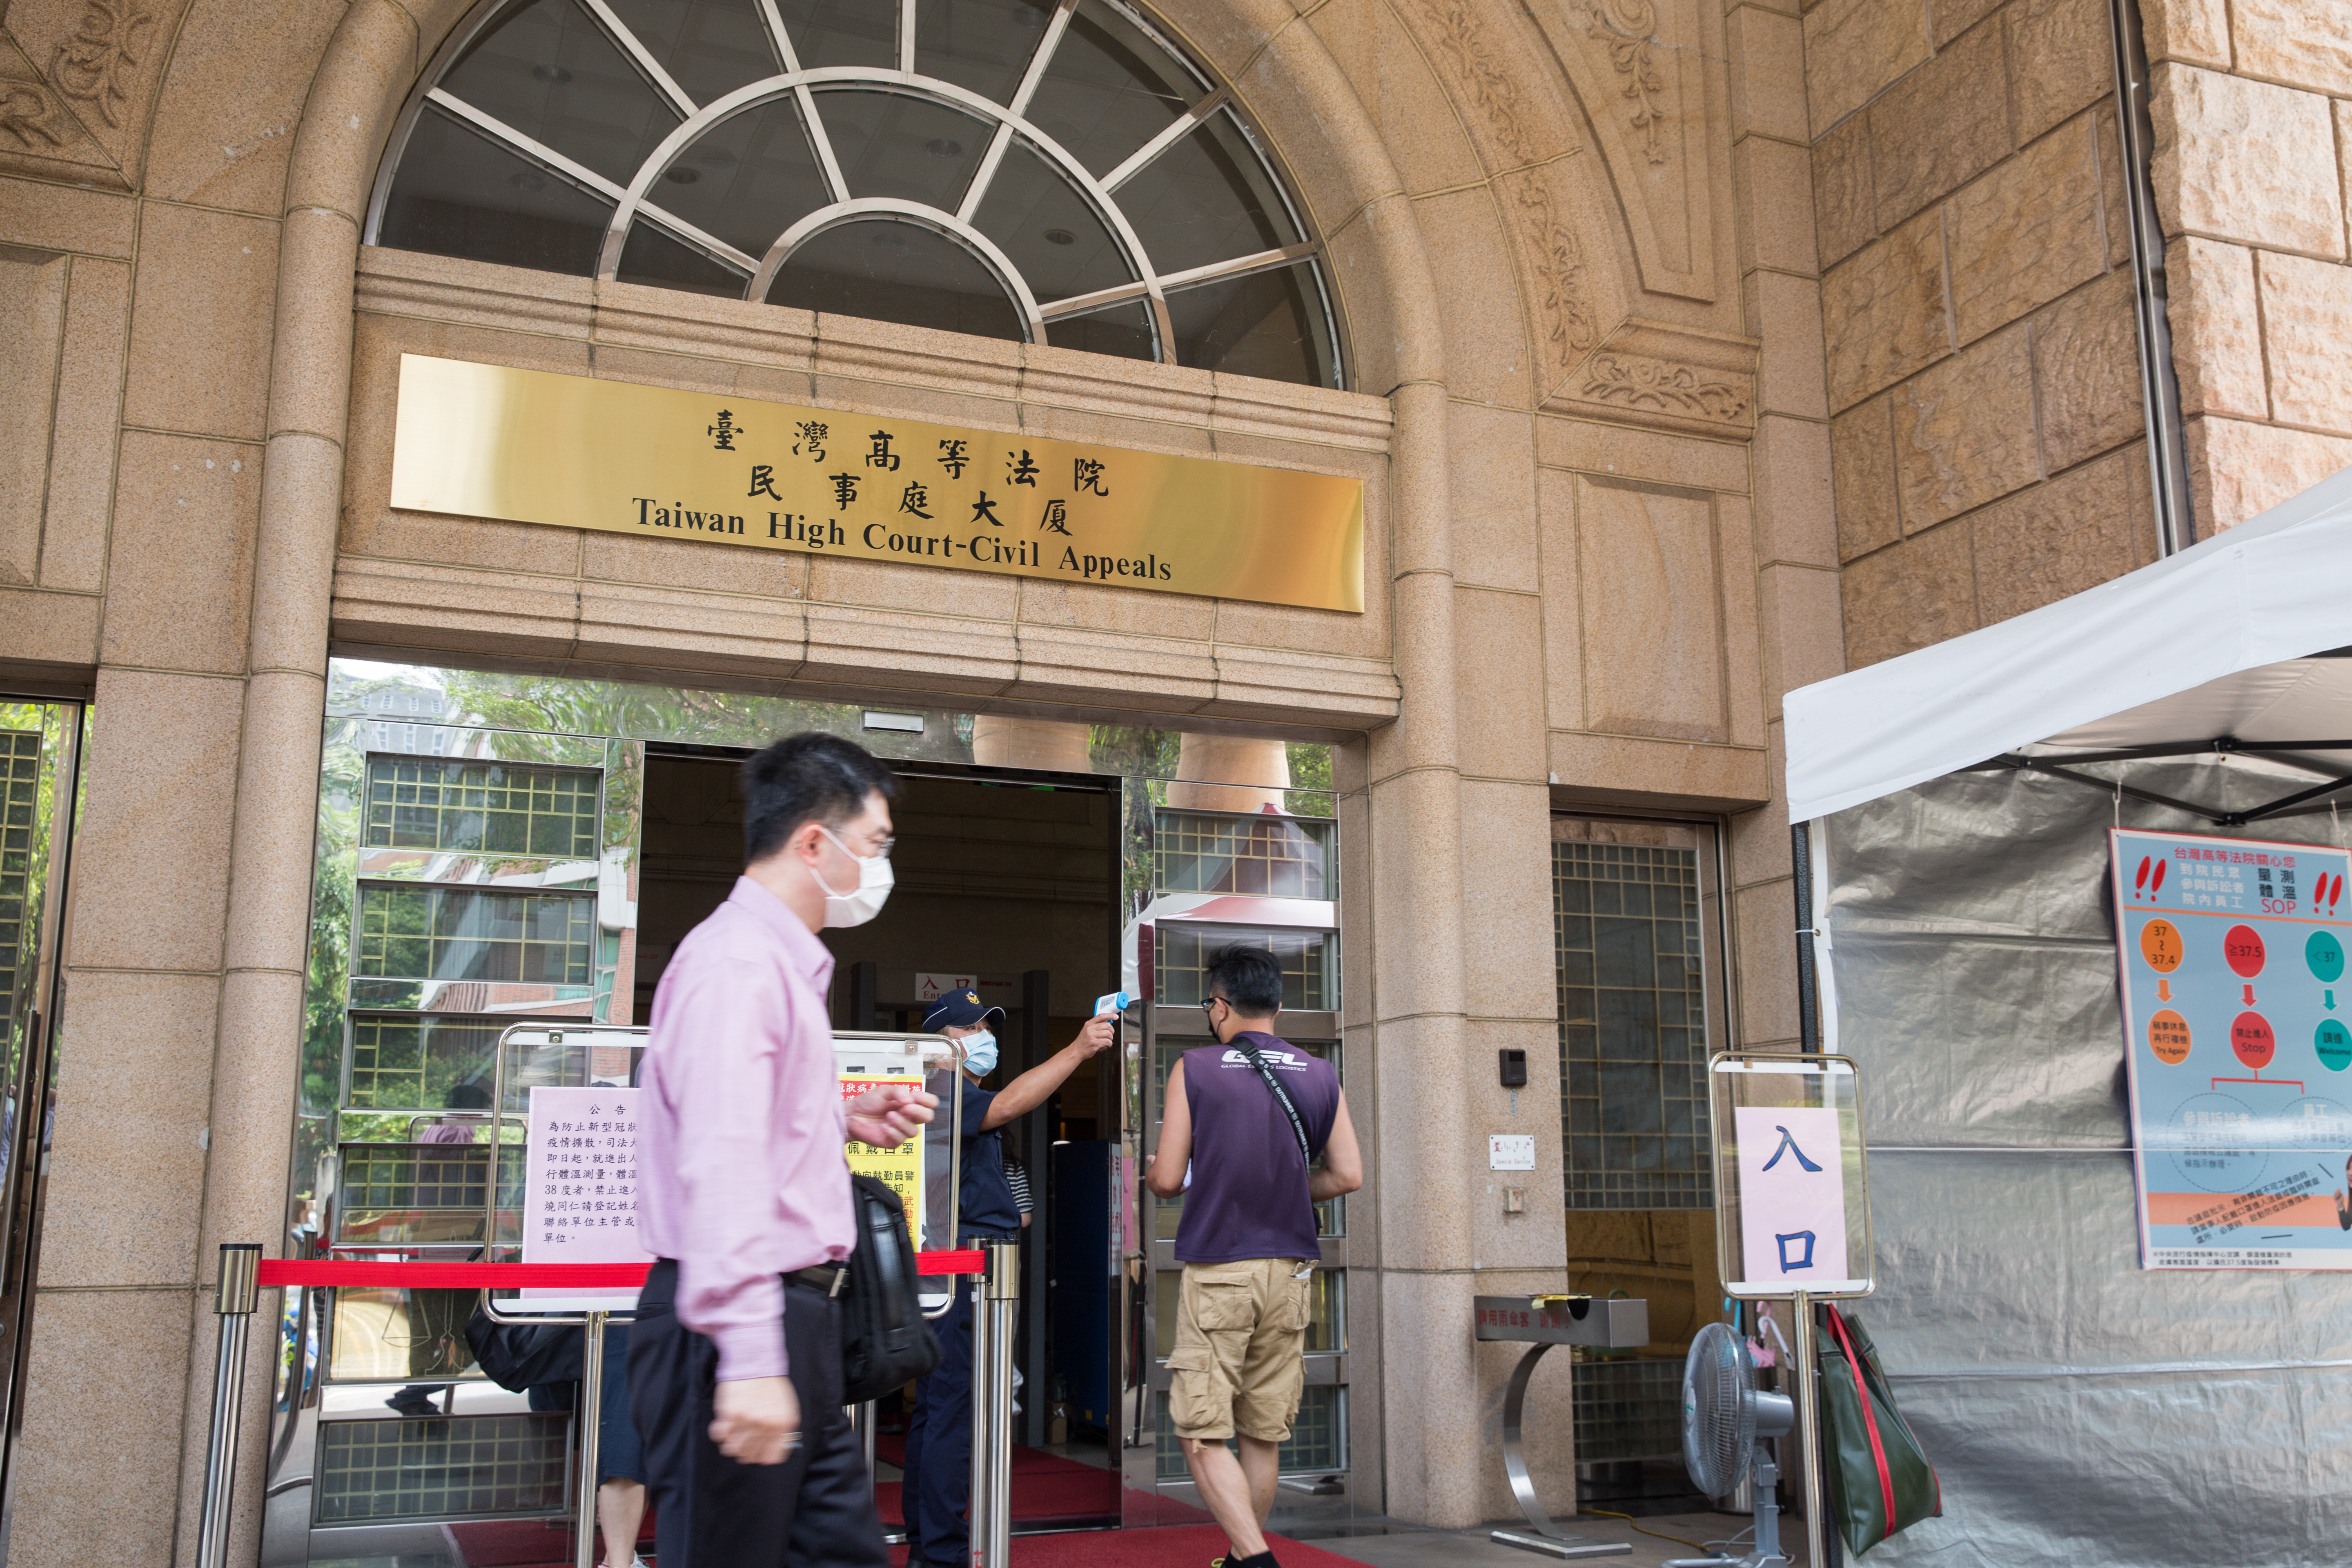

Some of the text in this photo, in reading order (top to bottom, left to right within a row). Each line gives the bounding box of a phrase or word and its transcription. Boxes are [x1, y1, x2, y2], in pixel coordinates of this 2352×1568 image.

[632, 497, 1172, 580] Taiwan High Court-Civil Appeals
[2261, 898, 2297, 915] SOP
[2153, 926, 2167, 936] 37
[2151, 954, 2175, 965] 37.4
[923, 991, 944, 999] Ent
[2156, 1047, 2186, 1056] Try Again
[2241, 1042, 2266, 1054] Stop
[2317, 1047, 2351, 1056] Welcome
[589, 1104, 626, 1115] 公告
[548, 1121, 637, 1132] 為防止新型冠狀
[545, 1184, 557, 1195] 38
[1762, 1125, 1823, 1274] 入口
[543, 1216, 640, 1228] 聯絡單位主管或
